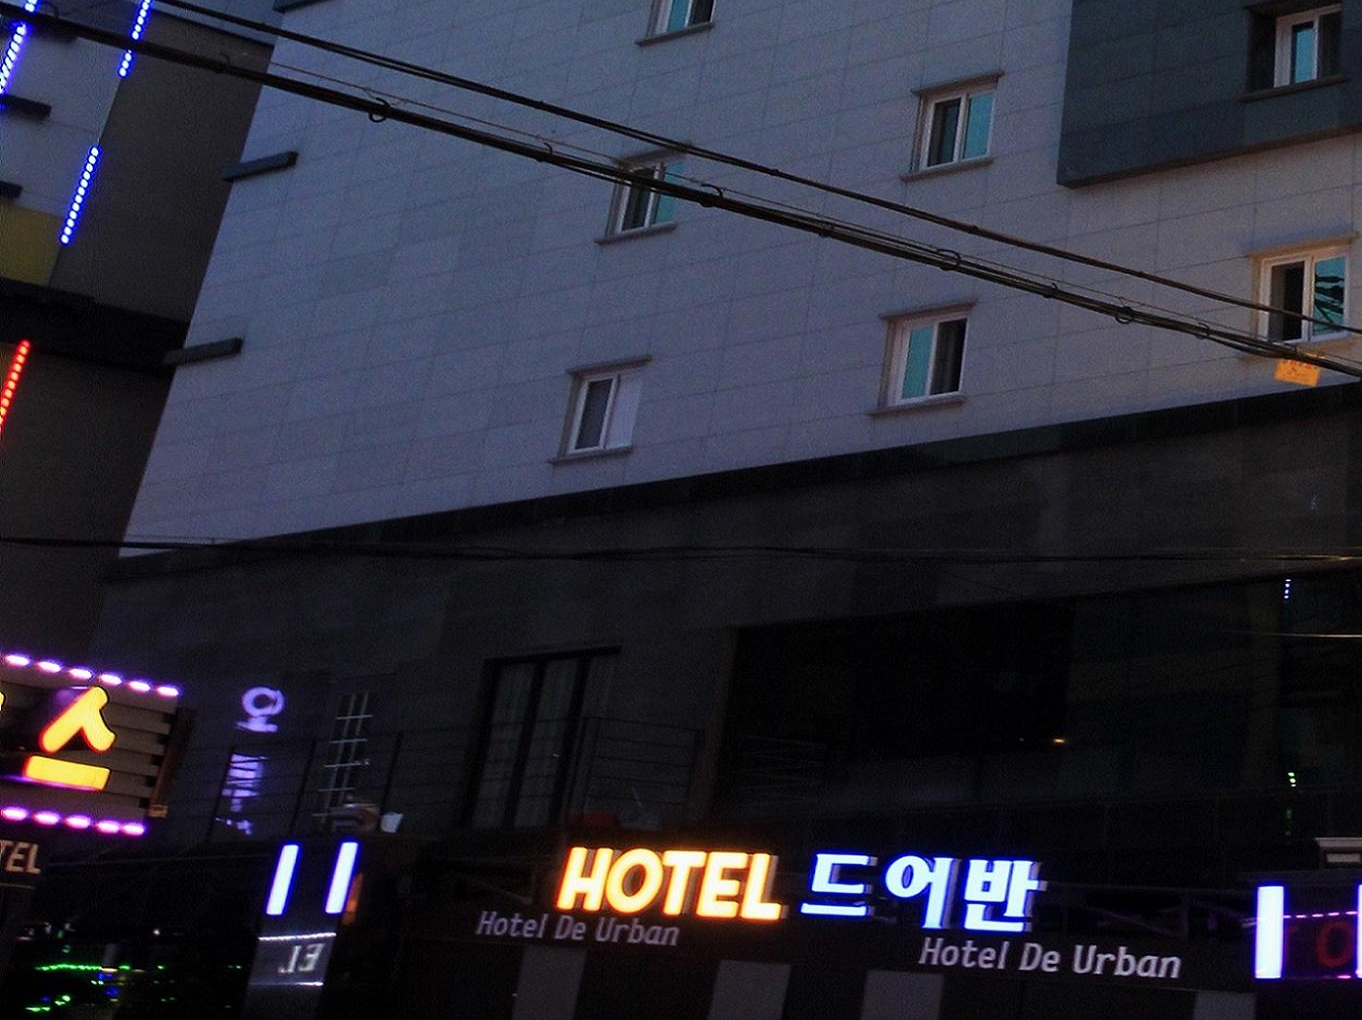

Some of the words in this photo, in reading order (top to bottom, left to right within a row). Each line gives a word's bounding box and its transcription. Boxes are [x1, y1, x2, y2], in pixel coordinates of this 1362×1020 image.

[555, 846, 784, 923] HOTEL
[799, 852, 1042, 933] 드어반
[475, 910, 550, 939] Hotel
[554, 914, 588, 942] De
[594, 916, 681, 947] Urban
[918, 936, 1011, 970] Hotel
[1018, 941, 1060, 973] De
[1072, 944, 1182, 980] Urban
